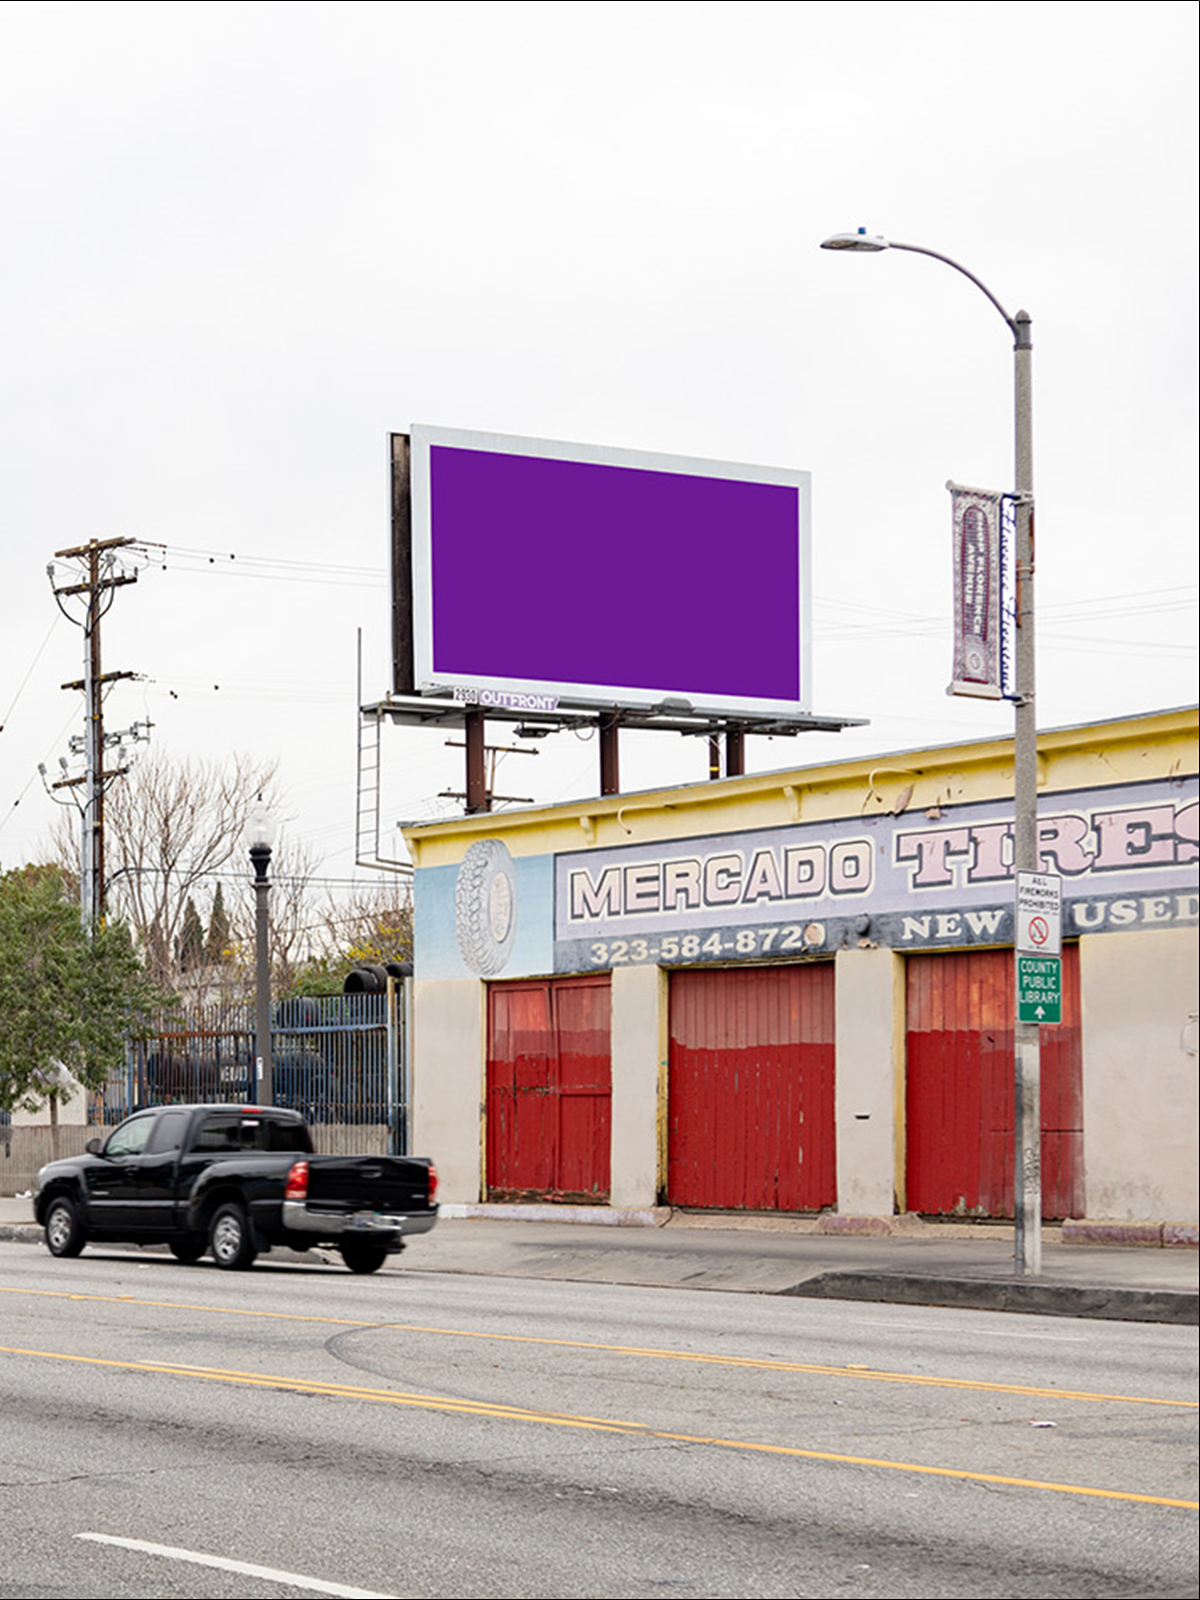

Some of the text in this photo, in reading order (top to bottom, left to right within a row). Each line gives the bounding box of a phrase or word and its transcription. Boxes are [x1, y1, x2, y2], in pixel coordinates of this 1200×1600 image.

[965, 543, 976, 604] AVENUE
[973, 555, 985, 634] FLORENCE
[570, 839, 873, 920] MERCADO
[1032, 877, 1047, 886] ALL
[1019, 886, 1059, 899] FIREWORKS
[1019, 898, 1060, 911] PROHIBITED
[902, 910, 1005, 940] NEW
[1020, 960, 1059, 974] COUNTY
[1022, 975, 1057, 989] PUBLIC
[1019, 990, 1061, 1004] LIBRARY
